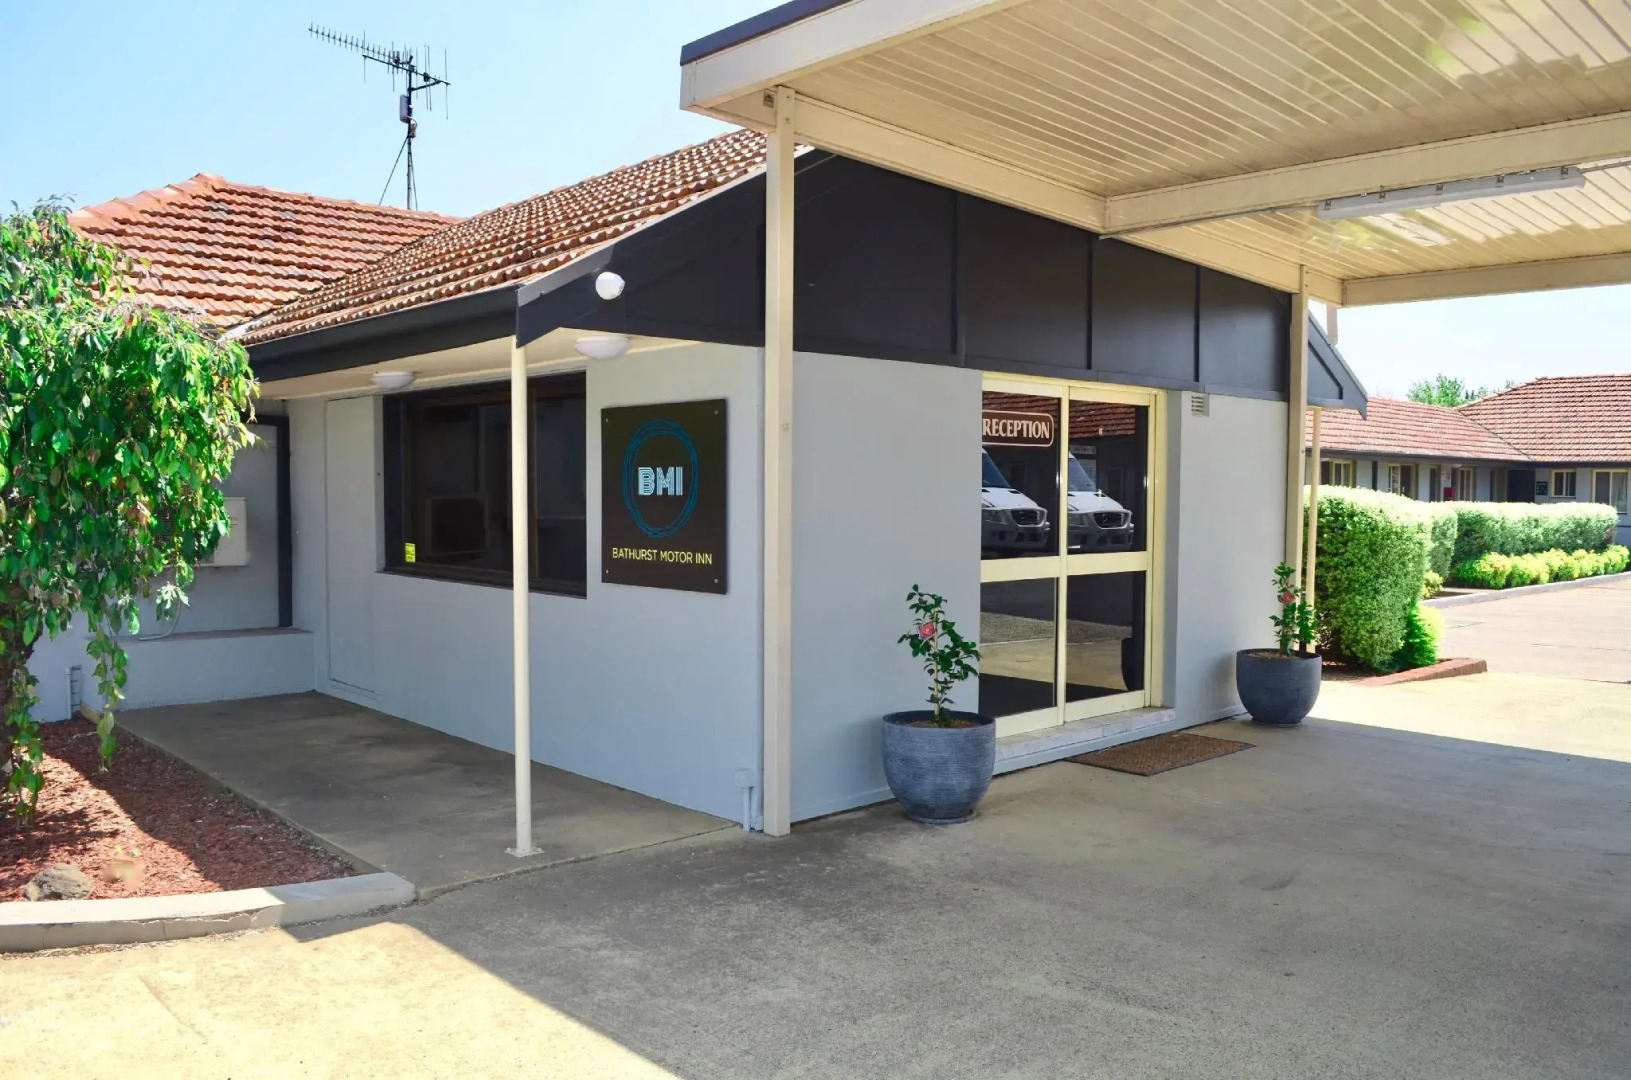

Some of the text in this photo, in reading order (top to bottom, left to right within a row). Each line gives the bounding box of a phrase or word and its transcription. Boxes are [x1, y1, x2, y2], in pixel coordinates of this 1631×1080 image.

[982, 418, 1050, 438] RECEPTION
[638, 466, 683, 495] BMI
[612, 547, 712, 565] BATHURST MOTOR INN
